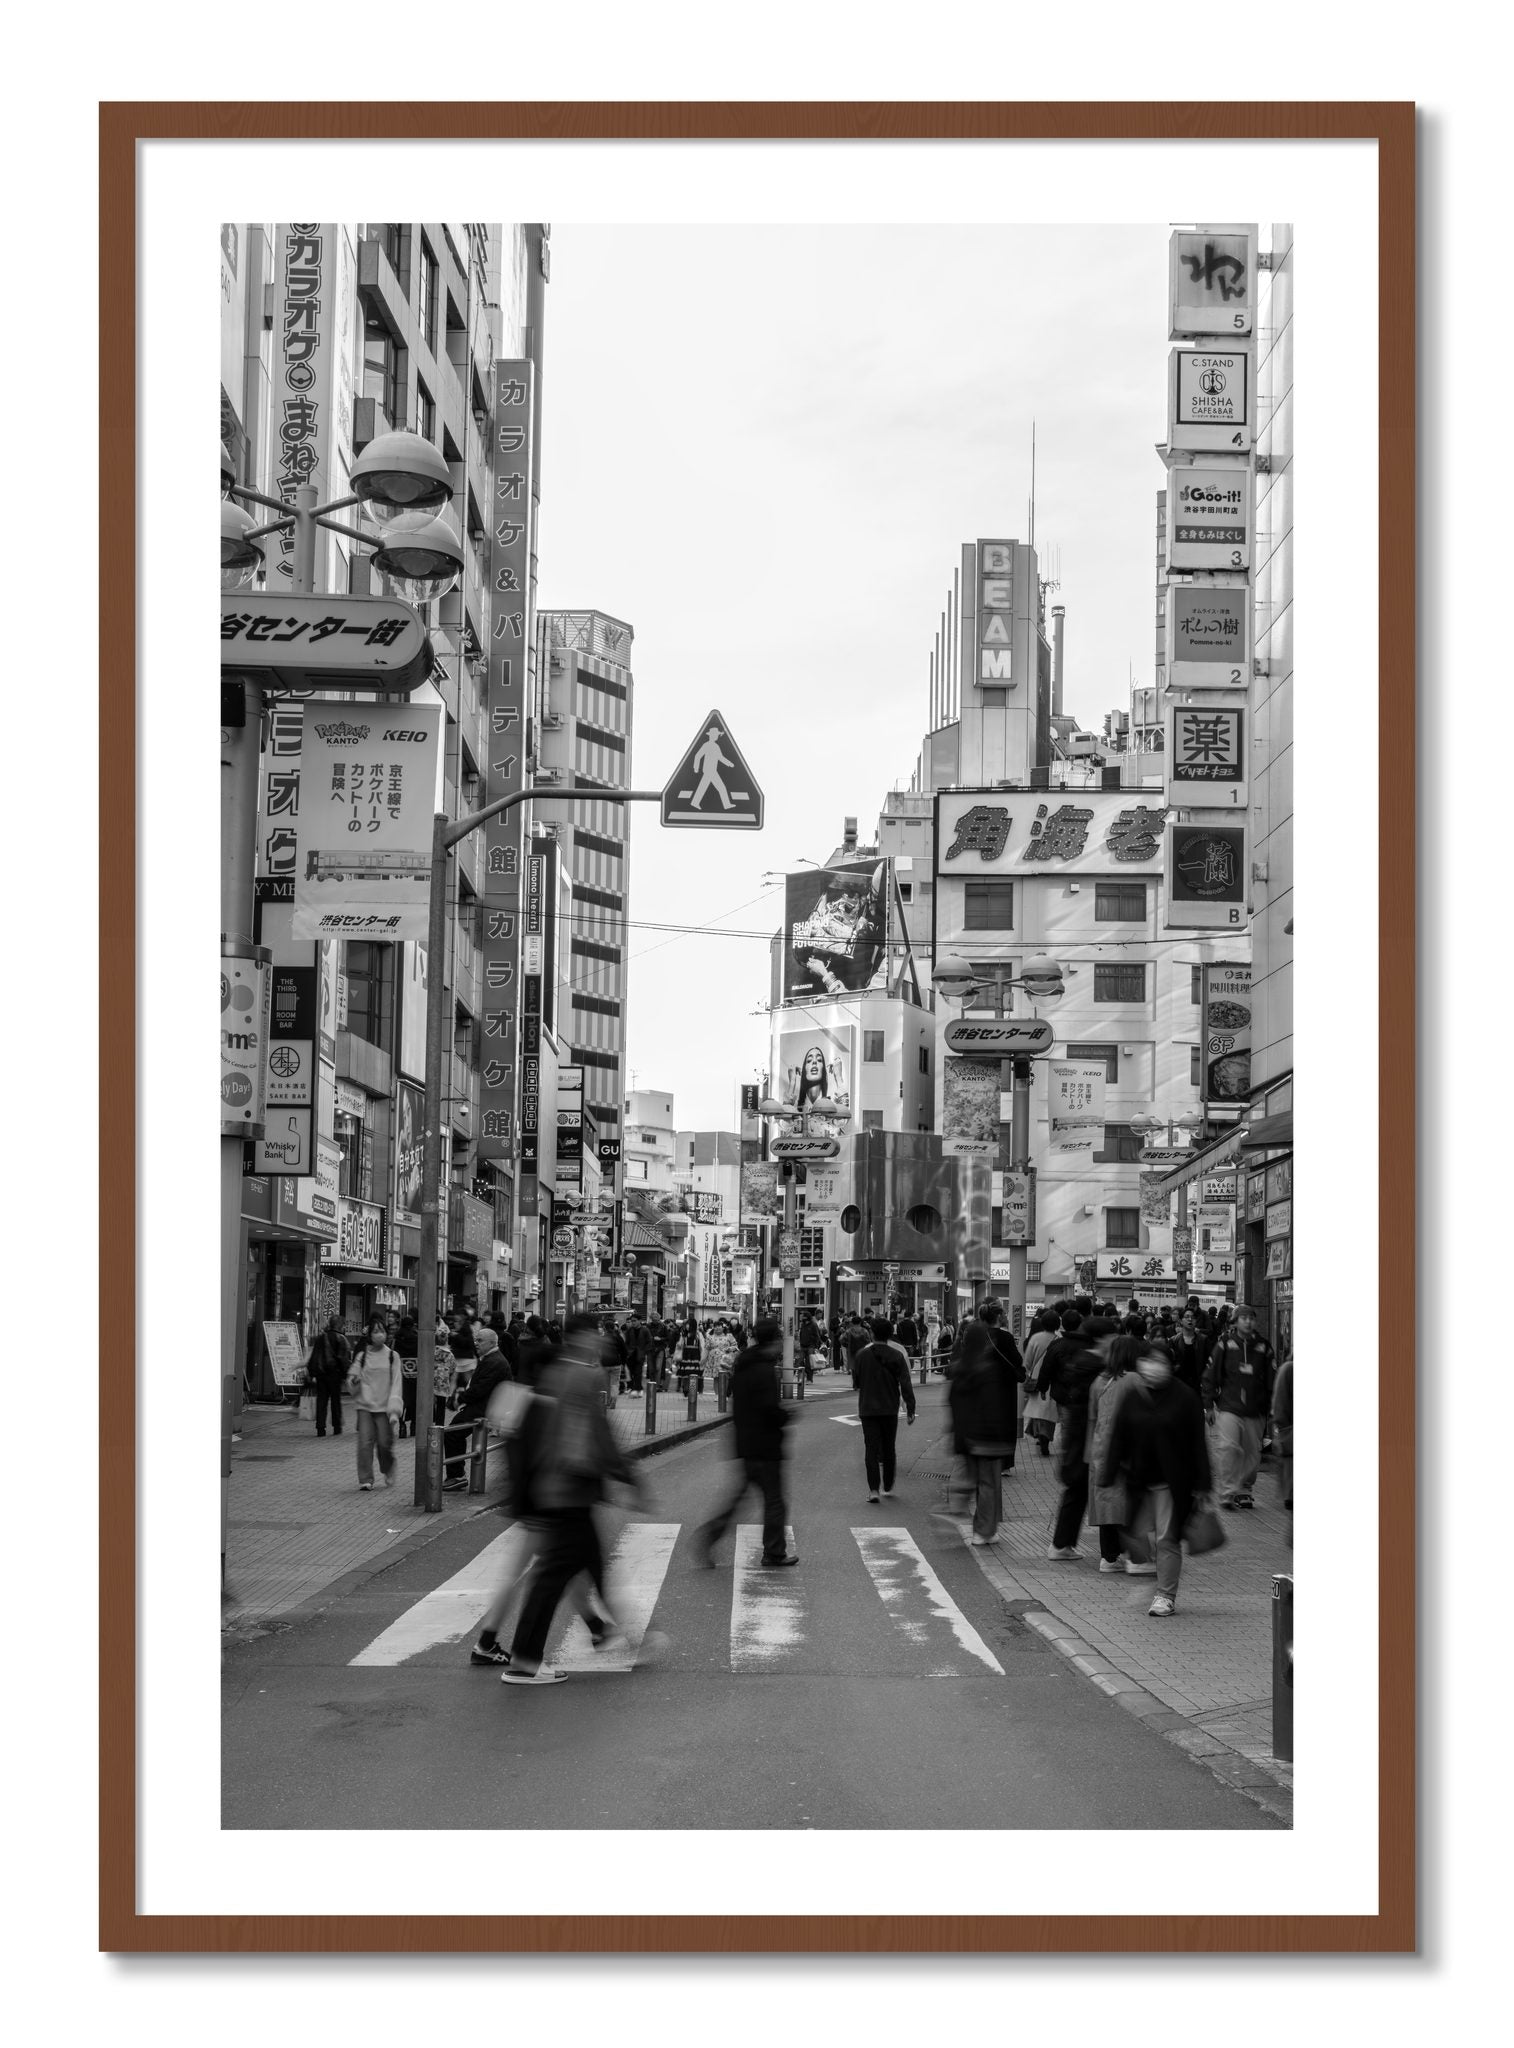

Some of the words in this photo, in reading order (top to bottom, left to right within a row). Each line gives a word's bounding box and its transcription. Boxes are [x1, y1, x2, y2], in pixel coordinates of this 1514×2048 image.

[1233, 314, 1245, 329] 5
[1192, 358, 1234, 368] C.STAND
[1192, 396, 1234, 407] SHISHA
[1192, 406, 1234, 415] CAFE&BAR
[1232, 432, 1244, 447] 4
[1190, 487, 1241, 502] Goo-it!
[1184, 505, 1239, 515] 渋谷宇田川町店
[1179, 529, 1242, 541] 全身もみほぐし
[1232, 550, 1243, 565] 3
[981, 545, 1013, 679] BEAM
[1230, 668, 1242, 684] 2
[326, 737, 359, 745] KANTO
[382, 729, 428, 743] KEIO
[1183, 714, 1230, 762] 薬
[331, 763, 346, 803] 冒険へ
[348, 763, 365, 833] カントーの
[387, 764, 403, 819] 京王線で
[1230, 788, 1238, 804] 1
[531, 859, 540, 893] kimono
[319, 914, 402, 928] 渋谷センター街
[530, 897, 539, 930] hearts
[1229, 908, 1240, 923] B
[276, 1011, 297, 1019] ROOM
[279, 1021, 294, 1029] BAR
[951, 1027, 1047, 1040] 渋谷センター街
[1208, 1035, 1235, 1055] 6F
[265, 1142, 297, 1153] Whisky
[601, 1145, 620, 1155] GU
[773, 1142, 832, 1151] 渋谷センター街
[264, 1151, 284, 1159] Bank
[1109, 1256, 1165, 1276] 兆楽
[710, 1255, 719, 1294] BEER
